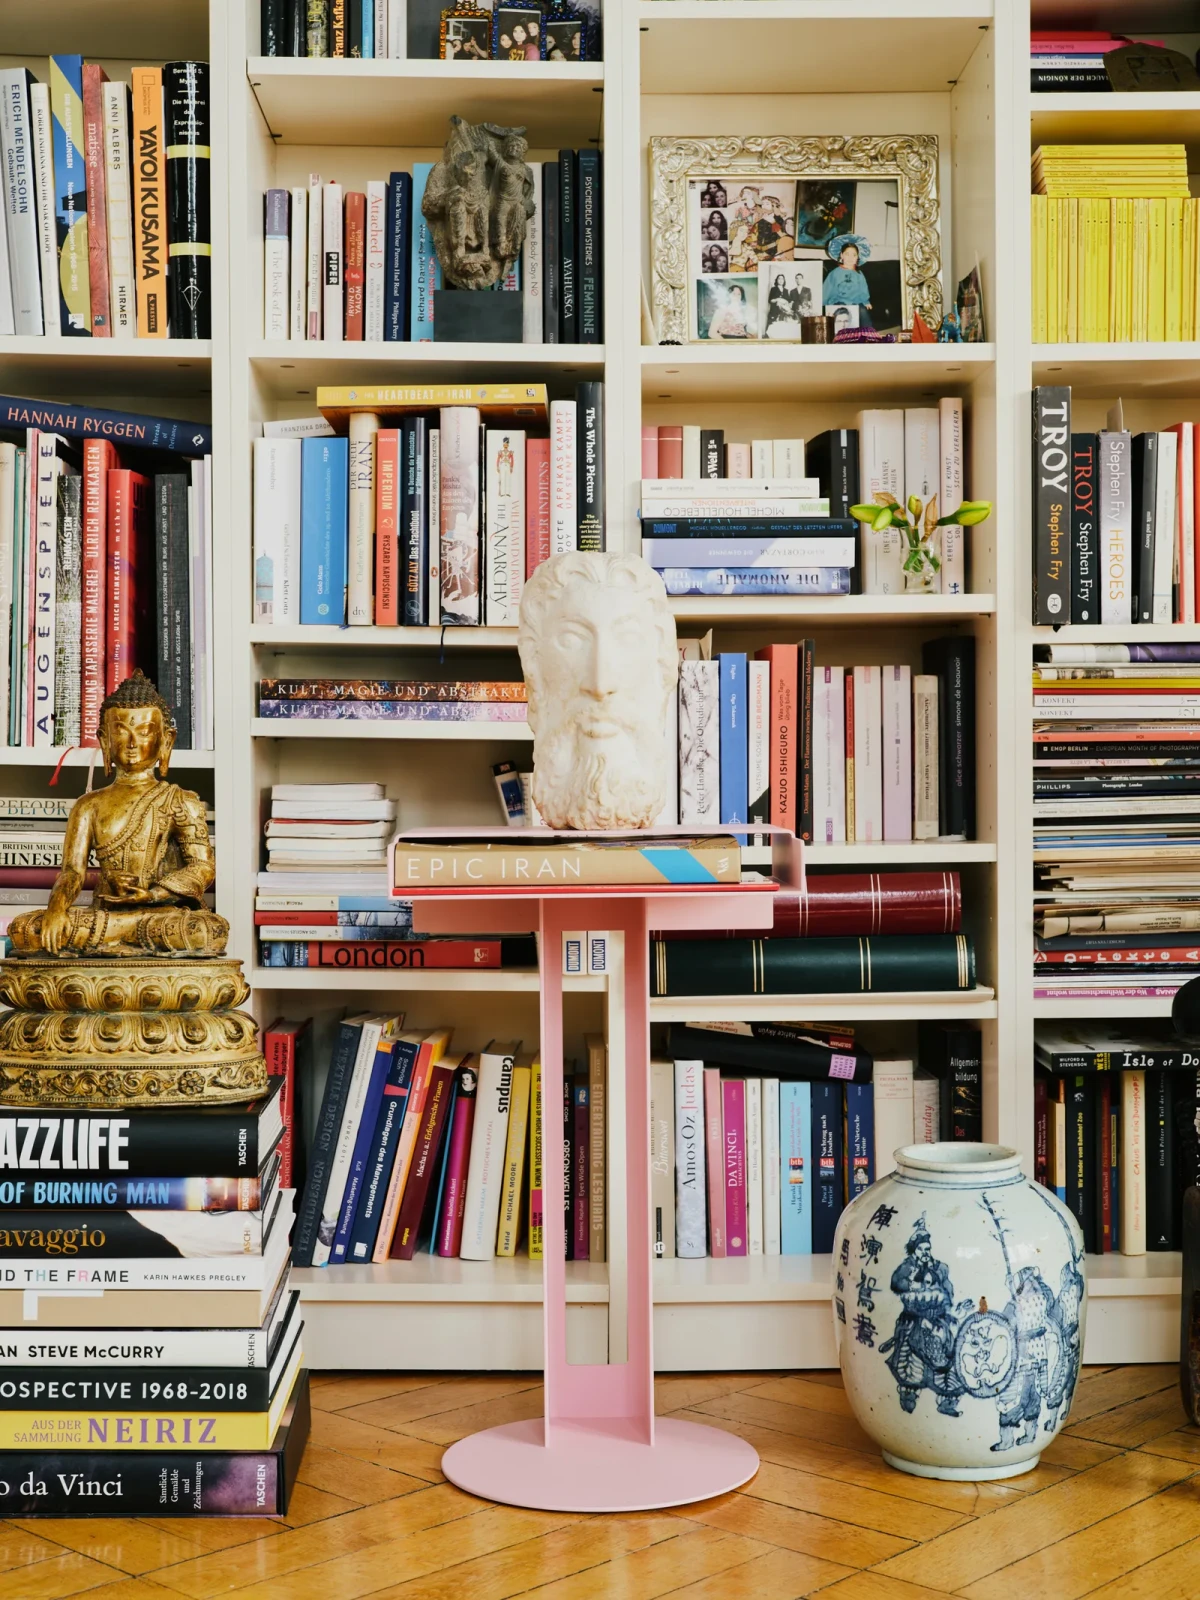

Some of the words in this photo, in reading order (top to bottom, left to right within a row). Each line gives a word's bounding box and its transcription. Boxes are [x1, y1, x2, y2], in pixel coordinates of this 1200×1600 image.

[11, 84, 22, 122] ERICH
[110, 96, 120, 122] ANNI
[112, 128, 122, 170] ALBERS
[140, 125, 159, 182] YAYOI
[14, 127, 28, 214] MENDELSOHN
[584, 176, 592, 225] PSYCHEDELIC
[141, 187, 160, 280] KUSAMA
[370, 194, 383, 253] Attached
[329, 253, 337, 283] PIPER
[119, 286, 127, 326] HIRMER
[584, 277, 594, 334] FEMININE
[8, 408, 77, 429] HANNAH
[83, 418, 146, 439] RYGGEN
[152, 423, 161, 446] Threads
[586, 408, 596, 429] The
[168, 424, 177, 449] Defiance
[586, 431, 596, 466] Whole
[1041, 402, 1068, 493] TROY
[87, 447, 100, 513] REIMKASTEN
[358, 441, 372, 489] IRAN
[1074, 446, 1093, 516] TROY
[1107, 441, 1124, 496] Stephen
[382, 460, 393, 510] IMPERIUM
[586, 468, 596, 504] Picture
[409, 510, 420, 544] Prachtboot
[497, 504, 506, 521] THE
[663, 506, 742, 516] HOUELLEBECQ
[744, 507, 785, 516] MICHEL
[1107, 501, 1124, 521] Fry
[87, 518, 99, 558] ULRICH
[1047, 504, 1062, 555] Stephen
[409, 546, 419, 559] Das
[490, 522, 509, 607] ANARCHY
[1076, 522, 1092, 575] Stephen
[1109, 529, 1124, 600] HEROES
[407, 575, 418, 592] GÖTZ
[408, 562, 418, 573] ALY
[715, 574, 789, 585] ANOMALIE
[796, 574, 819, 585] DIE
[1047, 560, 1063, 580] Fry
[86, 569, 98, 614] MALEREI
[382, 566, 391, 609] KAPUŚCIŃSKI
[1077, 579, 1092, 602] Fry
[85, 617, 98, 676] TAPISSERIE
[778, 678, 786, 695] Tage
[953, 657, 962, 688] beauvoir
[954, 689, 962, 698] de
[85, 680, 98, 740] ZEICHNUNG
[954, 700, 962, 726] simone
[778, 725, 788, 776] ISHIGURO
[954, 731, 962, 767] schwarzer
[954, 769, 962, 786] alice
[779, 778, 788, 814] KAZUO
[407, 858, 484, 879] EPIC
[501, 857, 582, 878] IRAN
[318, 941, 425, 968] London
[566, 942, 580, 971] DUMONT
[592, 939, 606, 970] DUMONT
[950, 1057, 980, 1068] Allgemein-
[1123, 1053, 1155, 1067] Isle
[1181, 1054, 1199, 1066] Do
[497, 1056, 514, 1114] campus
[680, 1065, 698, 1111] Judas
[955, 1072, 978, 1083] bildung
[380, 1101, 397, 1145] Grundlagen
[593, 1083, 604, 1169] ENTERTAINING
[681, 1115, 695, 1140] Oz
[0, 1118, 130, 1170] AZZLIFE
[238, 1128, 247, 1166] TASCHEN
[376, 1147, 388, 1162] des
[652, 1120, 669, 1177] Bittersweet
[509, 1162, 517, 1187] MOORE
[682, 1143, 697, 1190] Amos
[790, 1158, 803, 1166] btb
[0, 1182, 25, 1204] OF
[33, 1182, 117, 1204] BURNING
[127, 1183, 170, 1204] MAN
[241, 1179, 249, 1210] TASCHEN
[364, 1163, 385, 1219] Managements
[506, 1189, 515, 1221] MICHAEL
[593, 1173, 604, 1231] LESBIANS
[0, 1224, 106, 1254] avaggio
[503, 1232, 511, 1251] PIPER
[24, 1270, 59, 1282] THE
[67, 1270, 129, 1283] FRAME
[28, 1346, 78, 1358] STEVE
[84, 1346, 165, 1359] McCURRY
[248, 1333, 256, 1368] TASCHEN
[0, 1382, 132, 1399] OSPECTIVE
[141, 1382, 248, 1400] 1968-2018
[14, 1432, 81, 1443] SAMMLUNG
[32, 1420, 54, 1430] AUS
[57, 1420, 81, 1430] DER
[87, 1418, 217, 1443] NEIRIZ
[19, 1471, 48, 1496] da
[56, 1473, 124, 1496] Vinci
[159, 1468, 168, 1503] Sämtliche
[170, 1469, 179, 1502] Gemälde
[182, 1478, 190, 1494] und
[194, 1461, 202, 1509] Zeichnungen
[256, 1464, 266, 1508] TASCHEN
